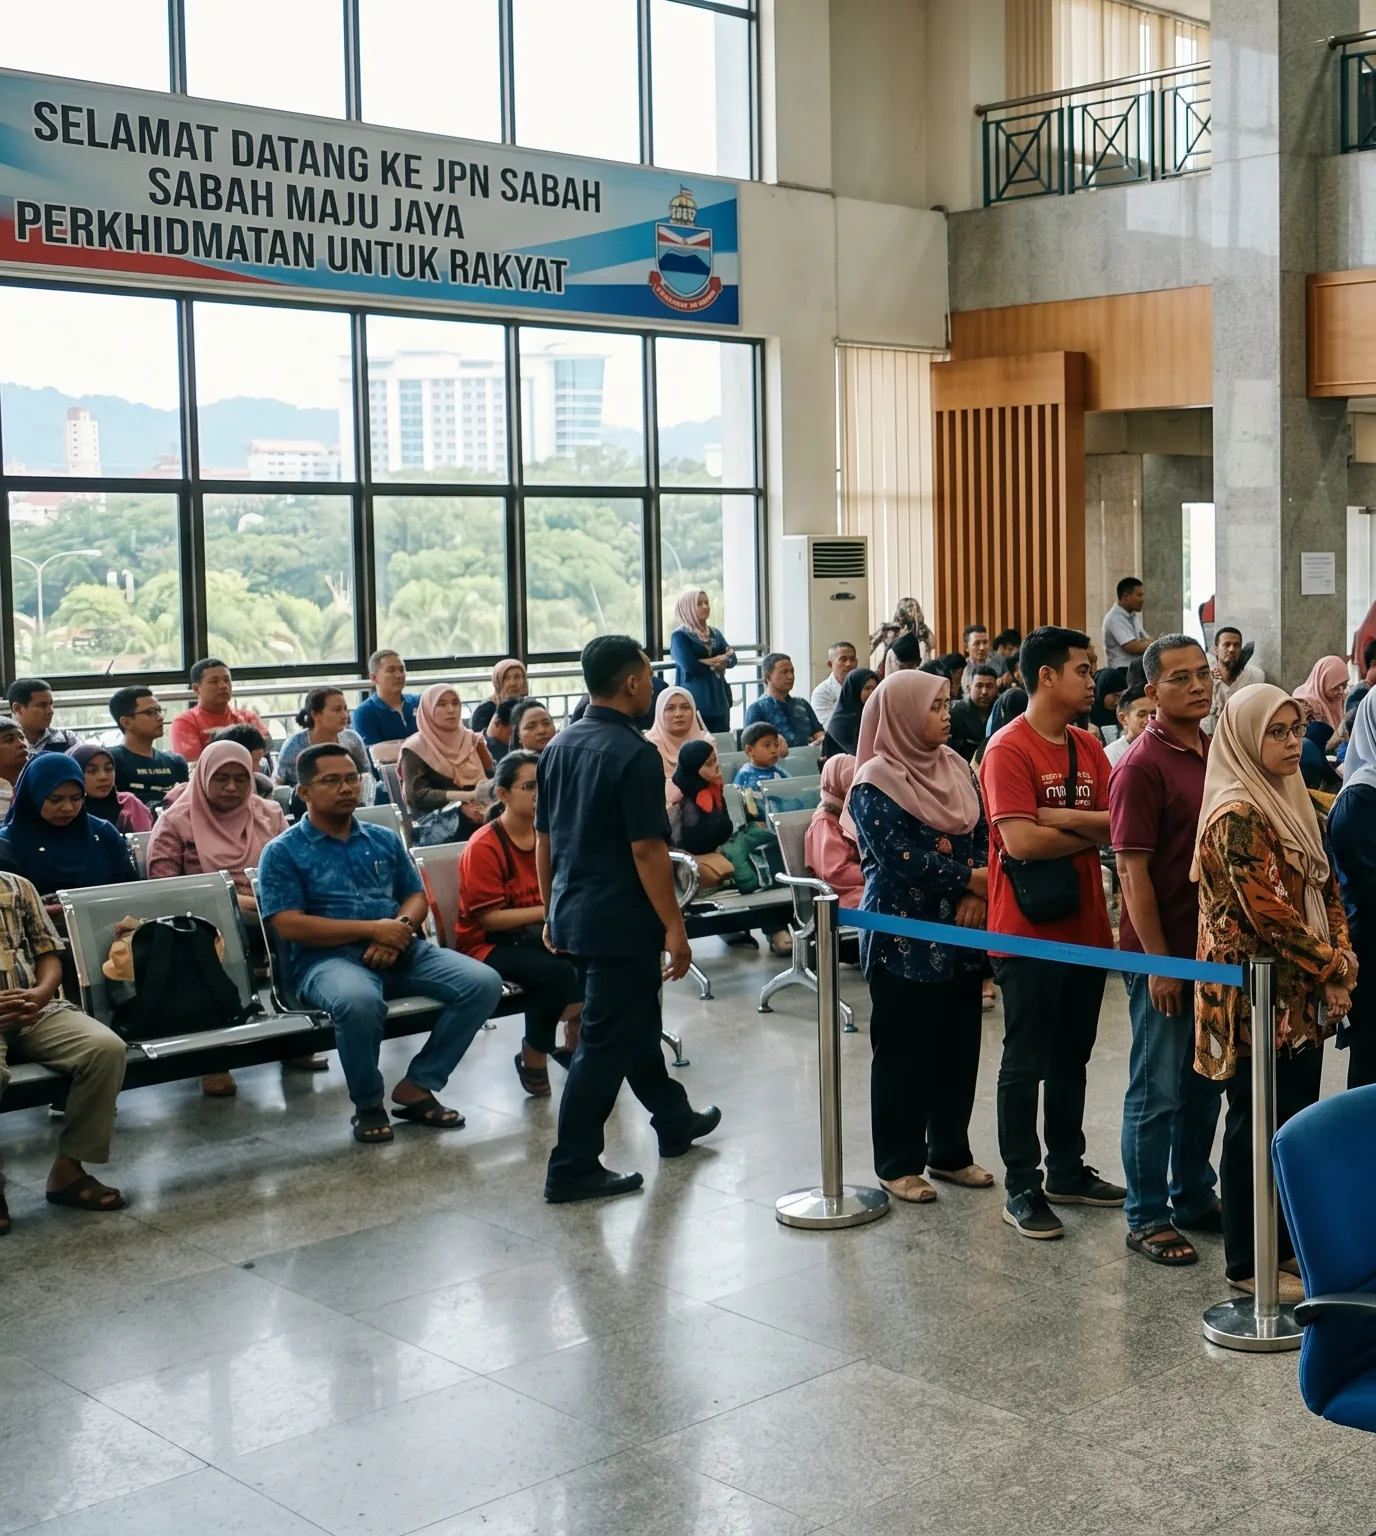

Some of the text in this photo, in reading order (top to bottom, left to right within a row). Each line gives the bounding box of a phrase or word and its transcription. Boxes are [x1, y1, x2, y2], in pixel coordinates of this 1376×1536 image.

[34, 102, 600, 213] SELAMAT DATANG KE JPN SABAH
[149, 167, 464, 239] SABAH MAJU JAYA
[17, 201, 568, 295] PERKHIDMATAN UNTUK RAKYAT
